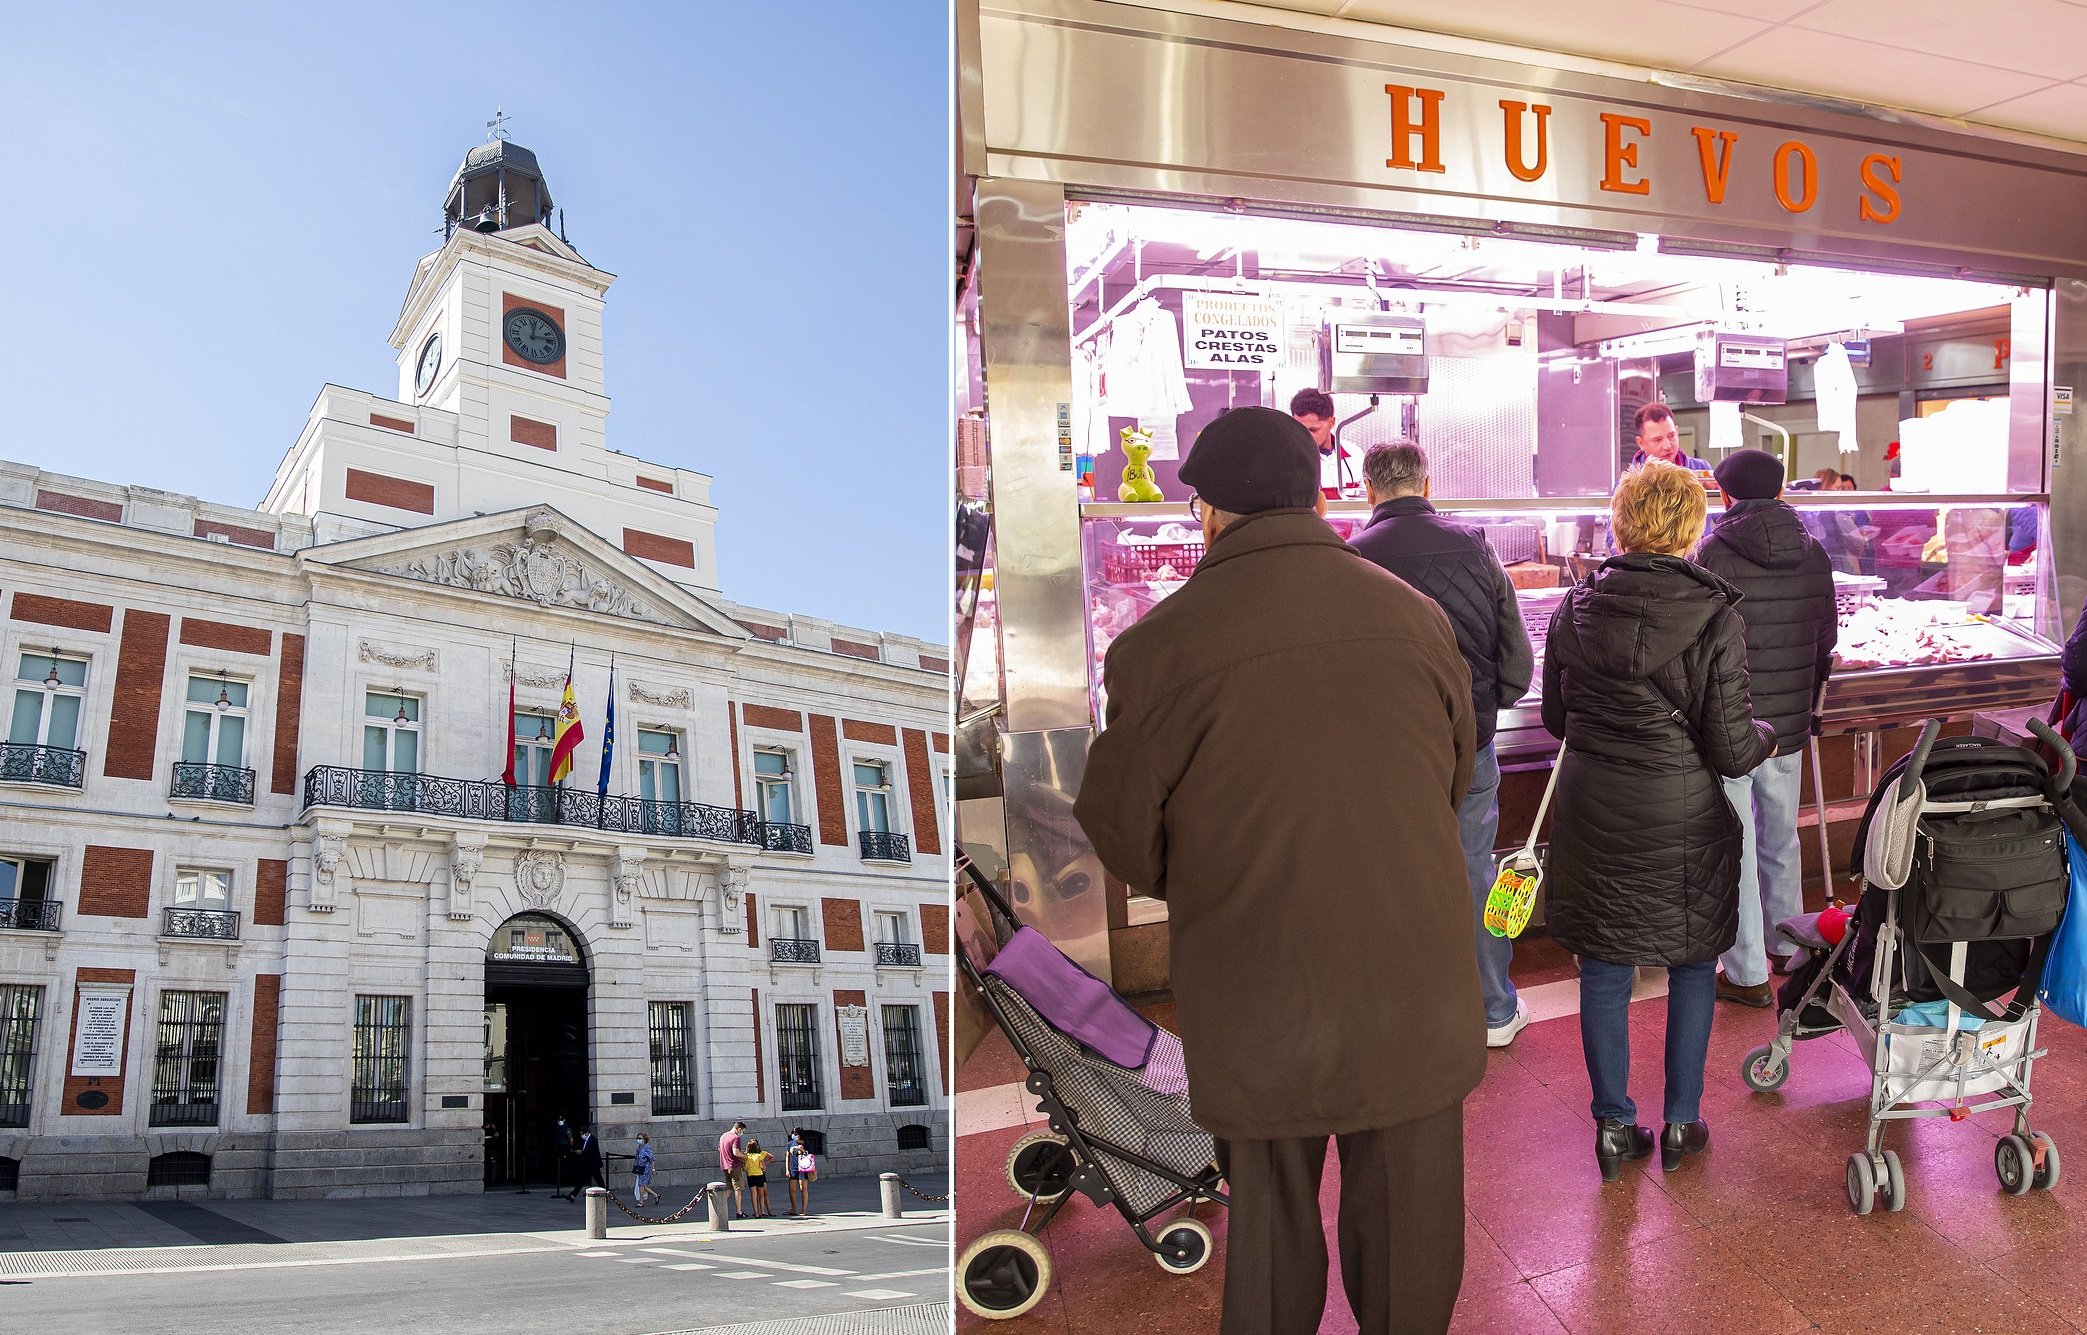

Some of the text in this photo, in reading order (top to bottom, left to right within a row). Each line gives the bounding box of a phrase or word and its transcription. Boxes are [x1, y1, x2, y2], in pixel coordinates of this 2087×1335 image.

[1385, 84, 1901, 224] HUEVOS
[1196, 300, 1276, 312] PRODUCTOS
[1194, 312, 1277, 328] CONGELADOS
[1201, 329, 1269, 341] PATOS
[1195, 340, 1278, 353] CRESTAS
[1210, 353, 1264, 364] ALAS
[1922, 352, 1933, 371] 2
[2057, 392, 2070, 400] VISA
[494, 952, 534, 960] COMUNIDAD
[512, 946, 556, 954] PRESIDENCIA
